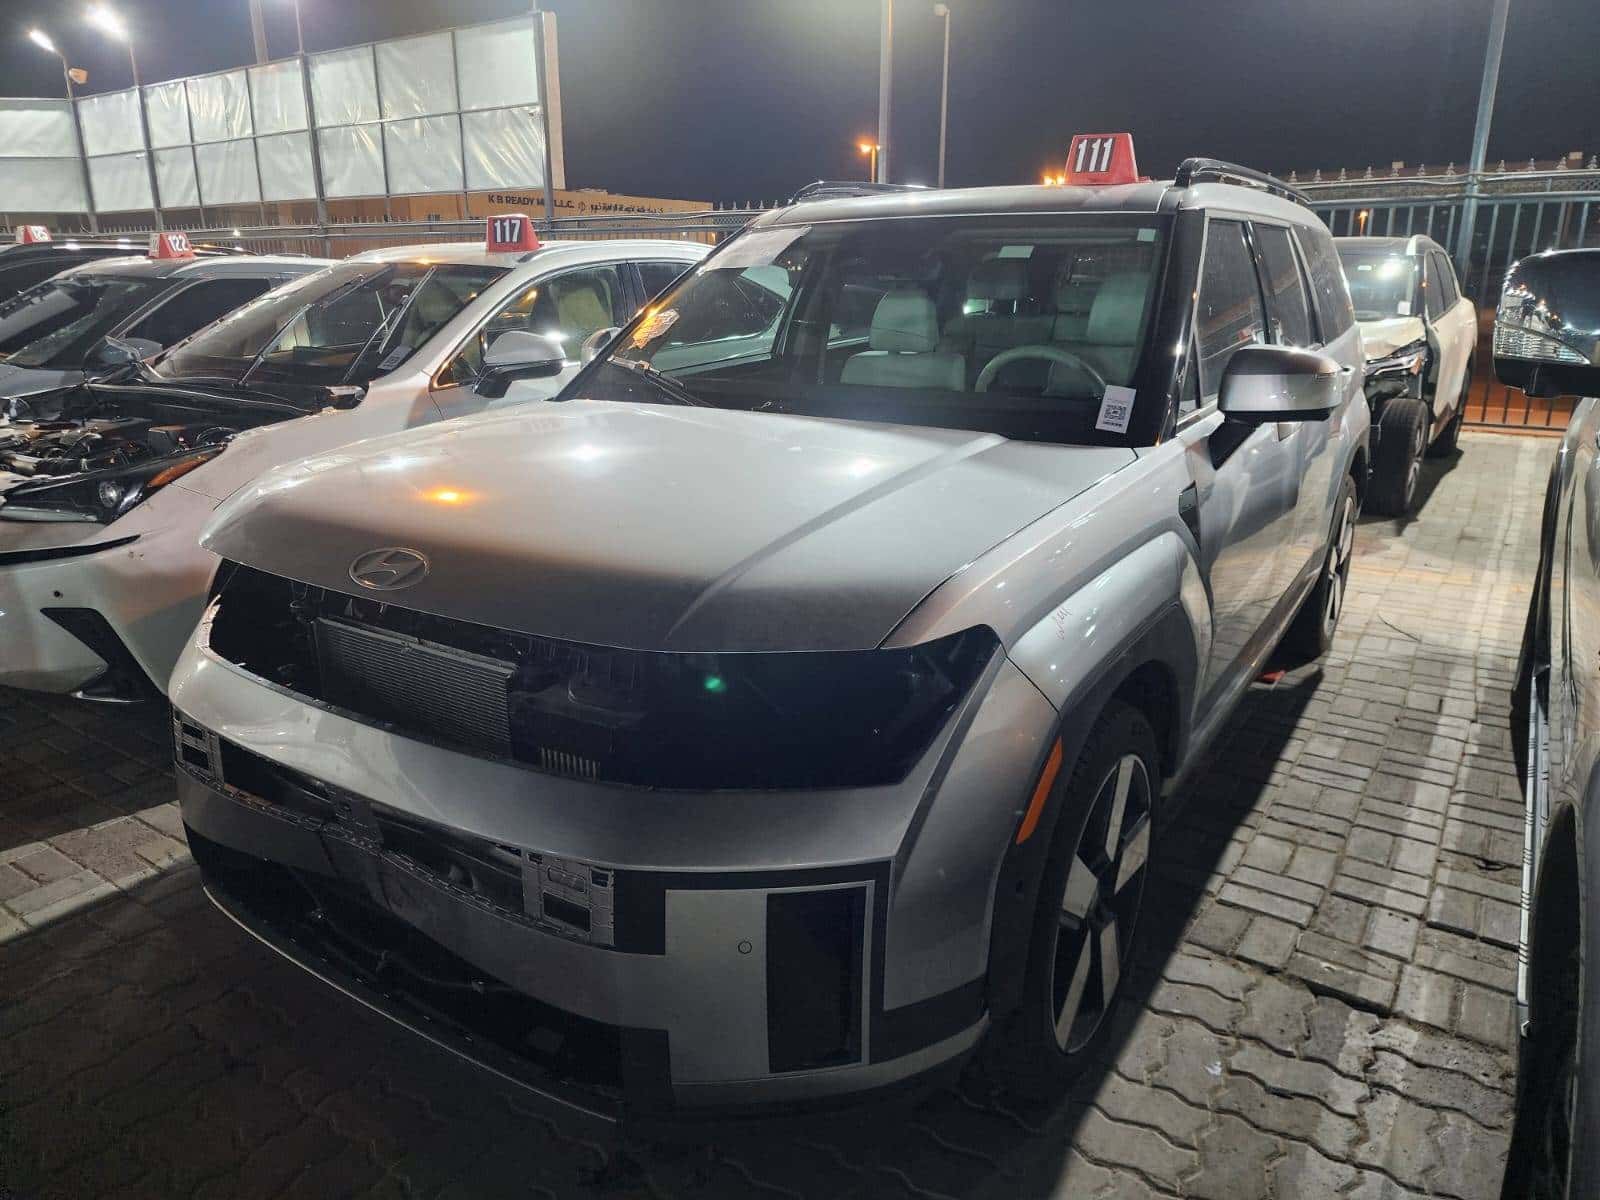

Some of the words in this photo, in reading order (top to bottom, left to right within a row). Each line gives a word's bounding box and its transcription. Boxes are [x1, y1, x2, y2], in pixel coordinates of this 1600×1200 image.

[1075, 138, 1113, 172] 111
[488, 194, 495, 204] K
[505, 195, 534, 206] READY
[494, 219, 521, 243] 117
[168, 233, 191, 252] 122
